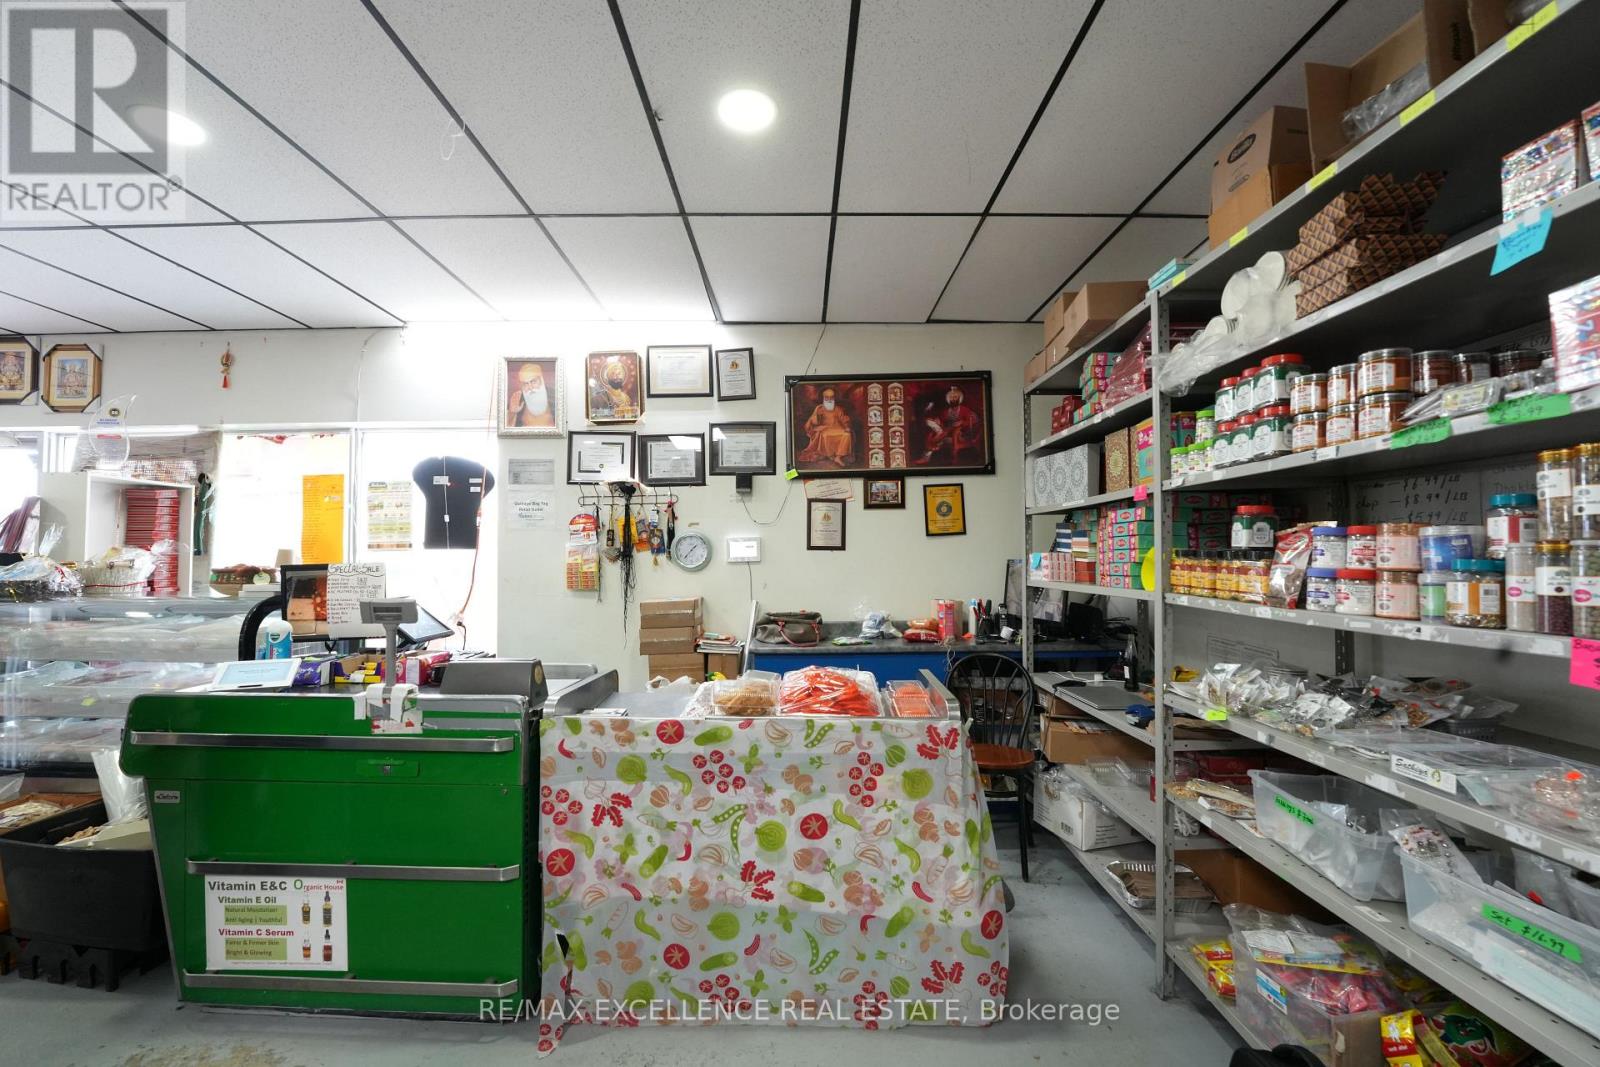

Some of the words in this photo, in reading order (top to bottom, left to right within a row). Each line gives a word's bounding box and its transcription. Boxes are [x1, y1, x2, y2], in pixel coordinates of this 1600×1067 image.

[208, 881, 256, 891] Vitamin
[260, 881, 288, 891] E&C
[294, 879, 323, 893] Organic
[218, 896, 253, 904] Vitamin
[255, 896, 262, 904] E
[264, 896, 277, 904] Oil
[1491, 910, 1512, 926] Set
[218, 928, 253, 936] Vitamin
[256, 928, 262, 936] C
[265, 928, 294, 936] Serum
[250, 949, 272, 957] Glowing
